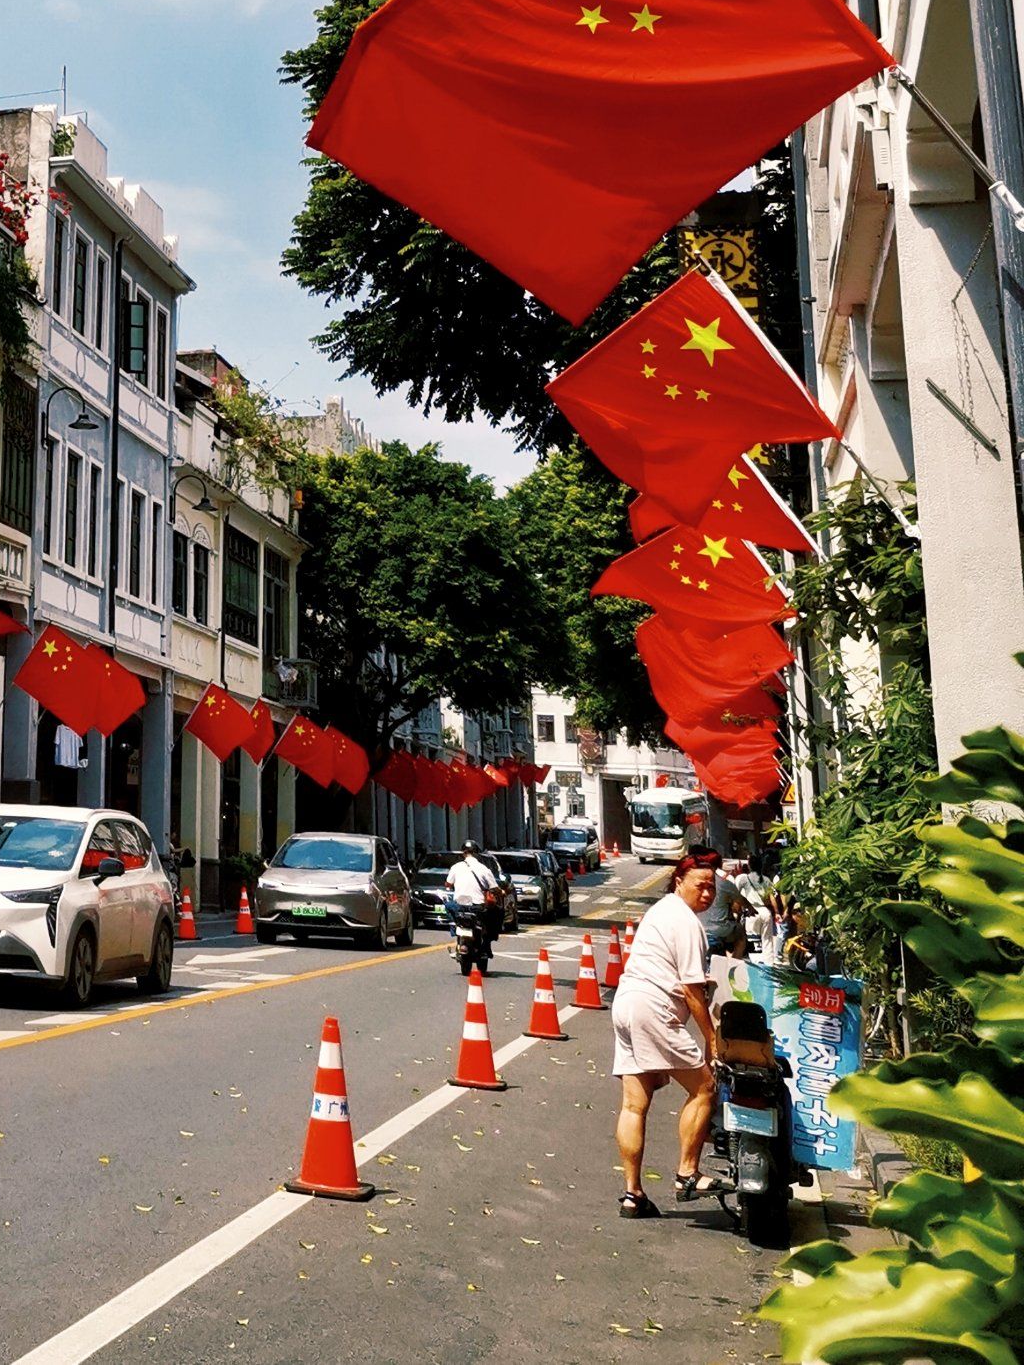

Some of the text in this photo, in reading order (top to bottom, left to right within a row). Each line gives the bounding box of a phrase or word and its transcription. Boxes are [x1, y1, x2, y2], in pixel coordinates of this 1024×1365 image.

[803, 987, 841, 1008] 正宗
[794, 1010, 844, 1156] 椰肉椰子汁
